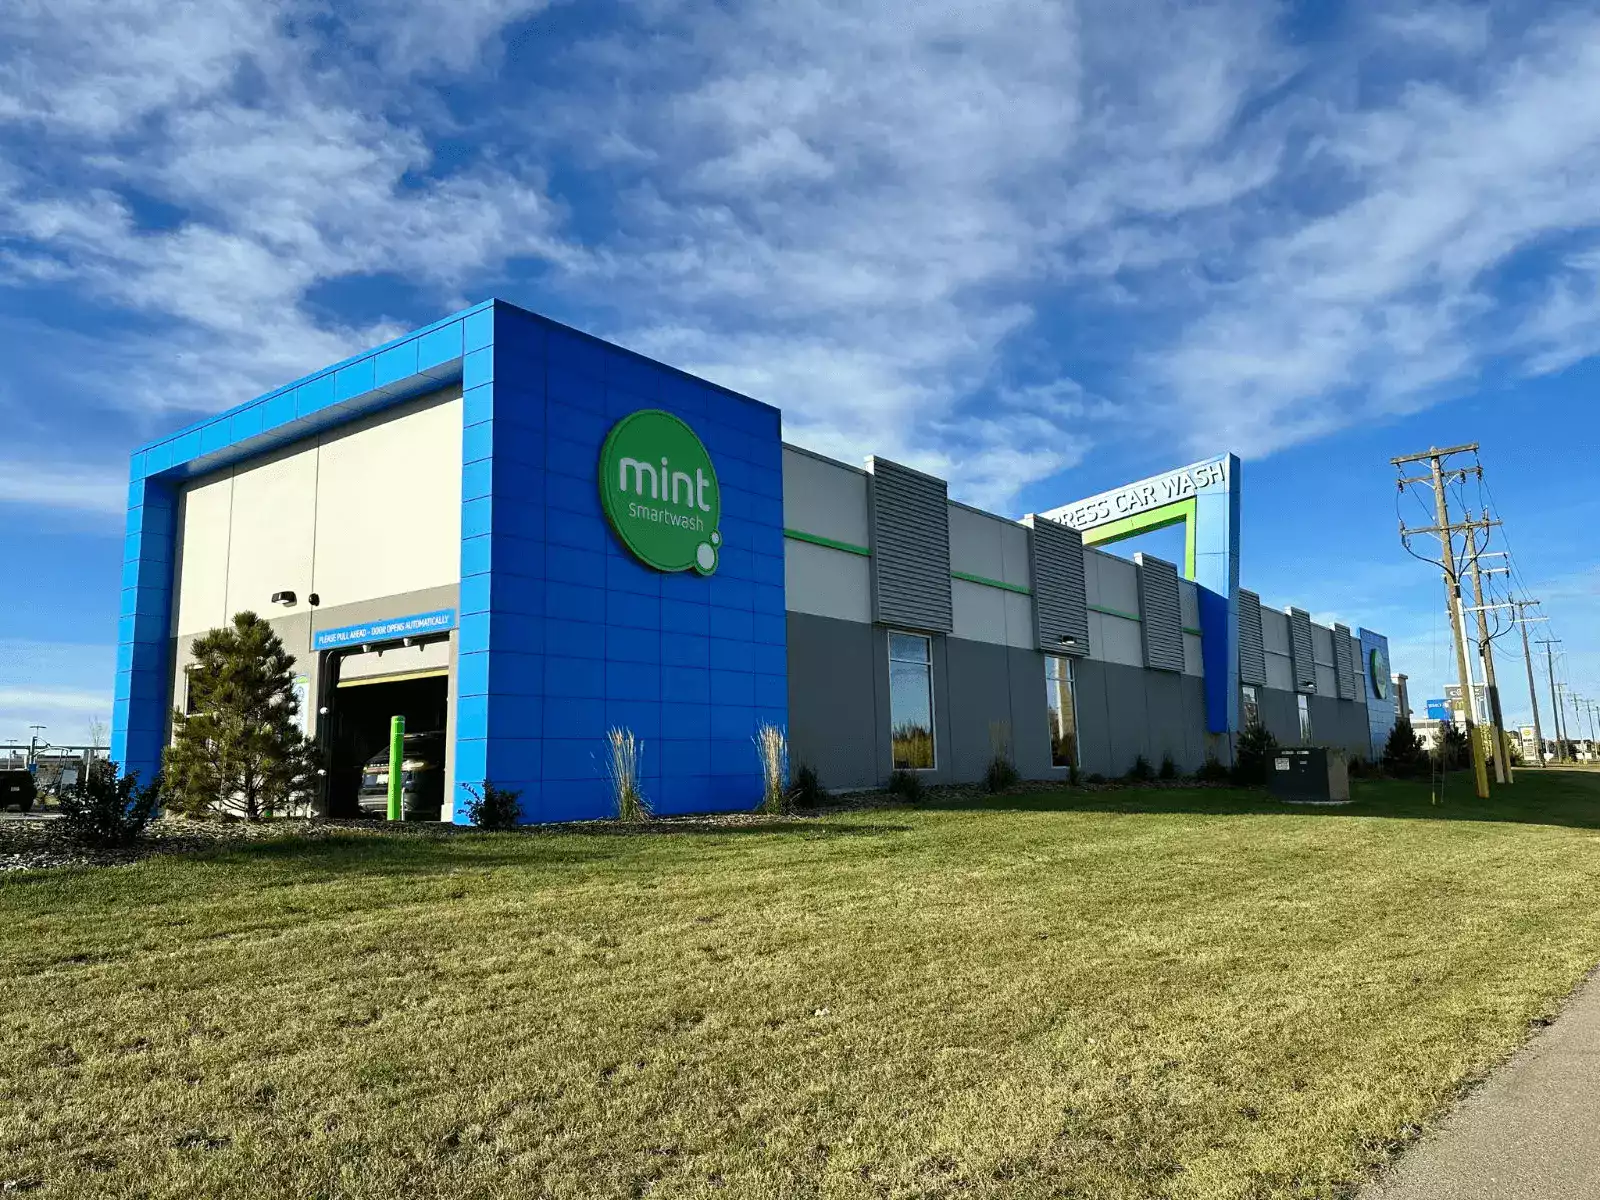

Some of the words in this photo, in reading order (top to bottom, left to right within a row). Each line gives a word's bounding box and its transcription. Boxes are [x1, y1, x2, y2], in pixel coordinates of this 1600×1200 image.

[619, 456, 711, 512] mint
[1113, 484, 1157, 512] CAR
[1160, 461, 1225, 498] WASH
[628, 502, 704, 532] smartwash
[318, 633, 337, 645] PLEASE
[337, 631, 349, 641] PULL
[350, 628, 367, 639] AHEAD
[371, 625, 386, 636] DOOR
[387, 622, 405, 633] OPENS
[405, 614, 449, 629] AUTOMATICALLY
